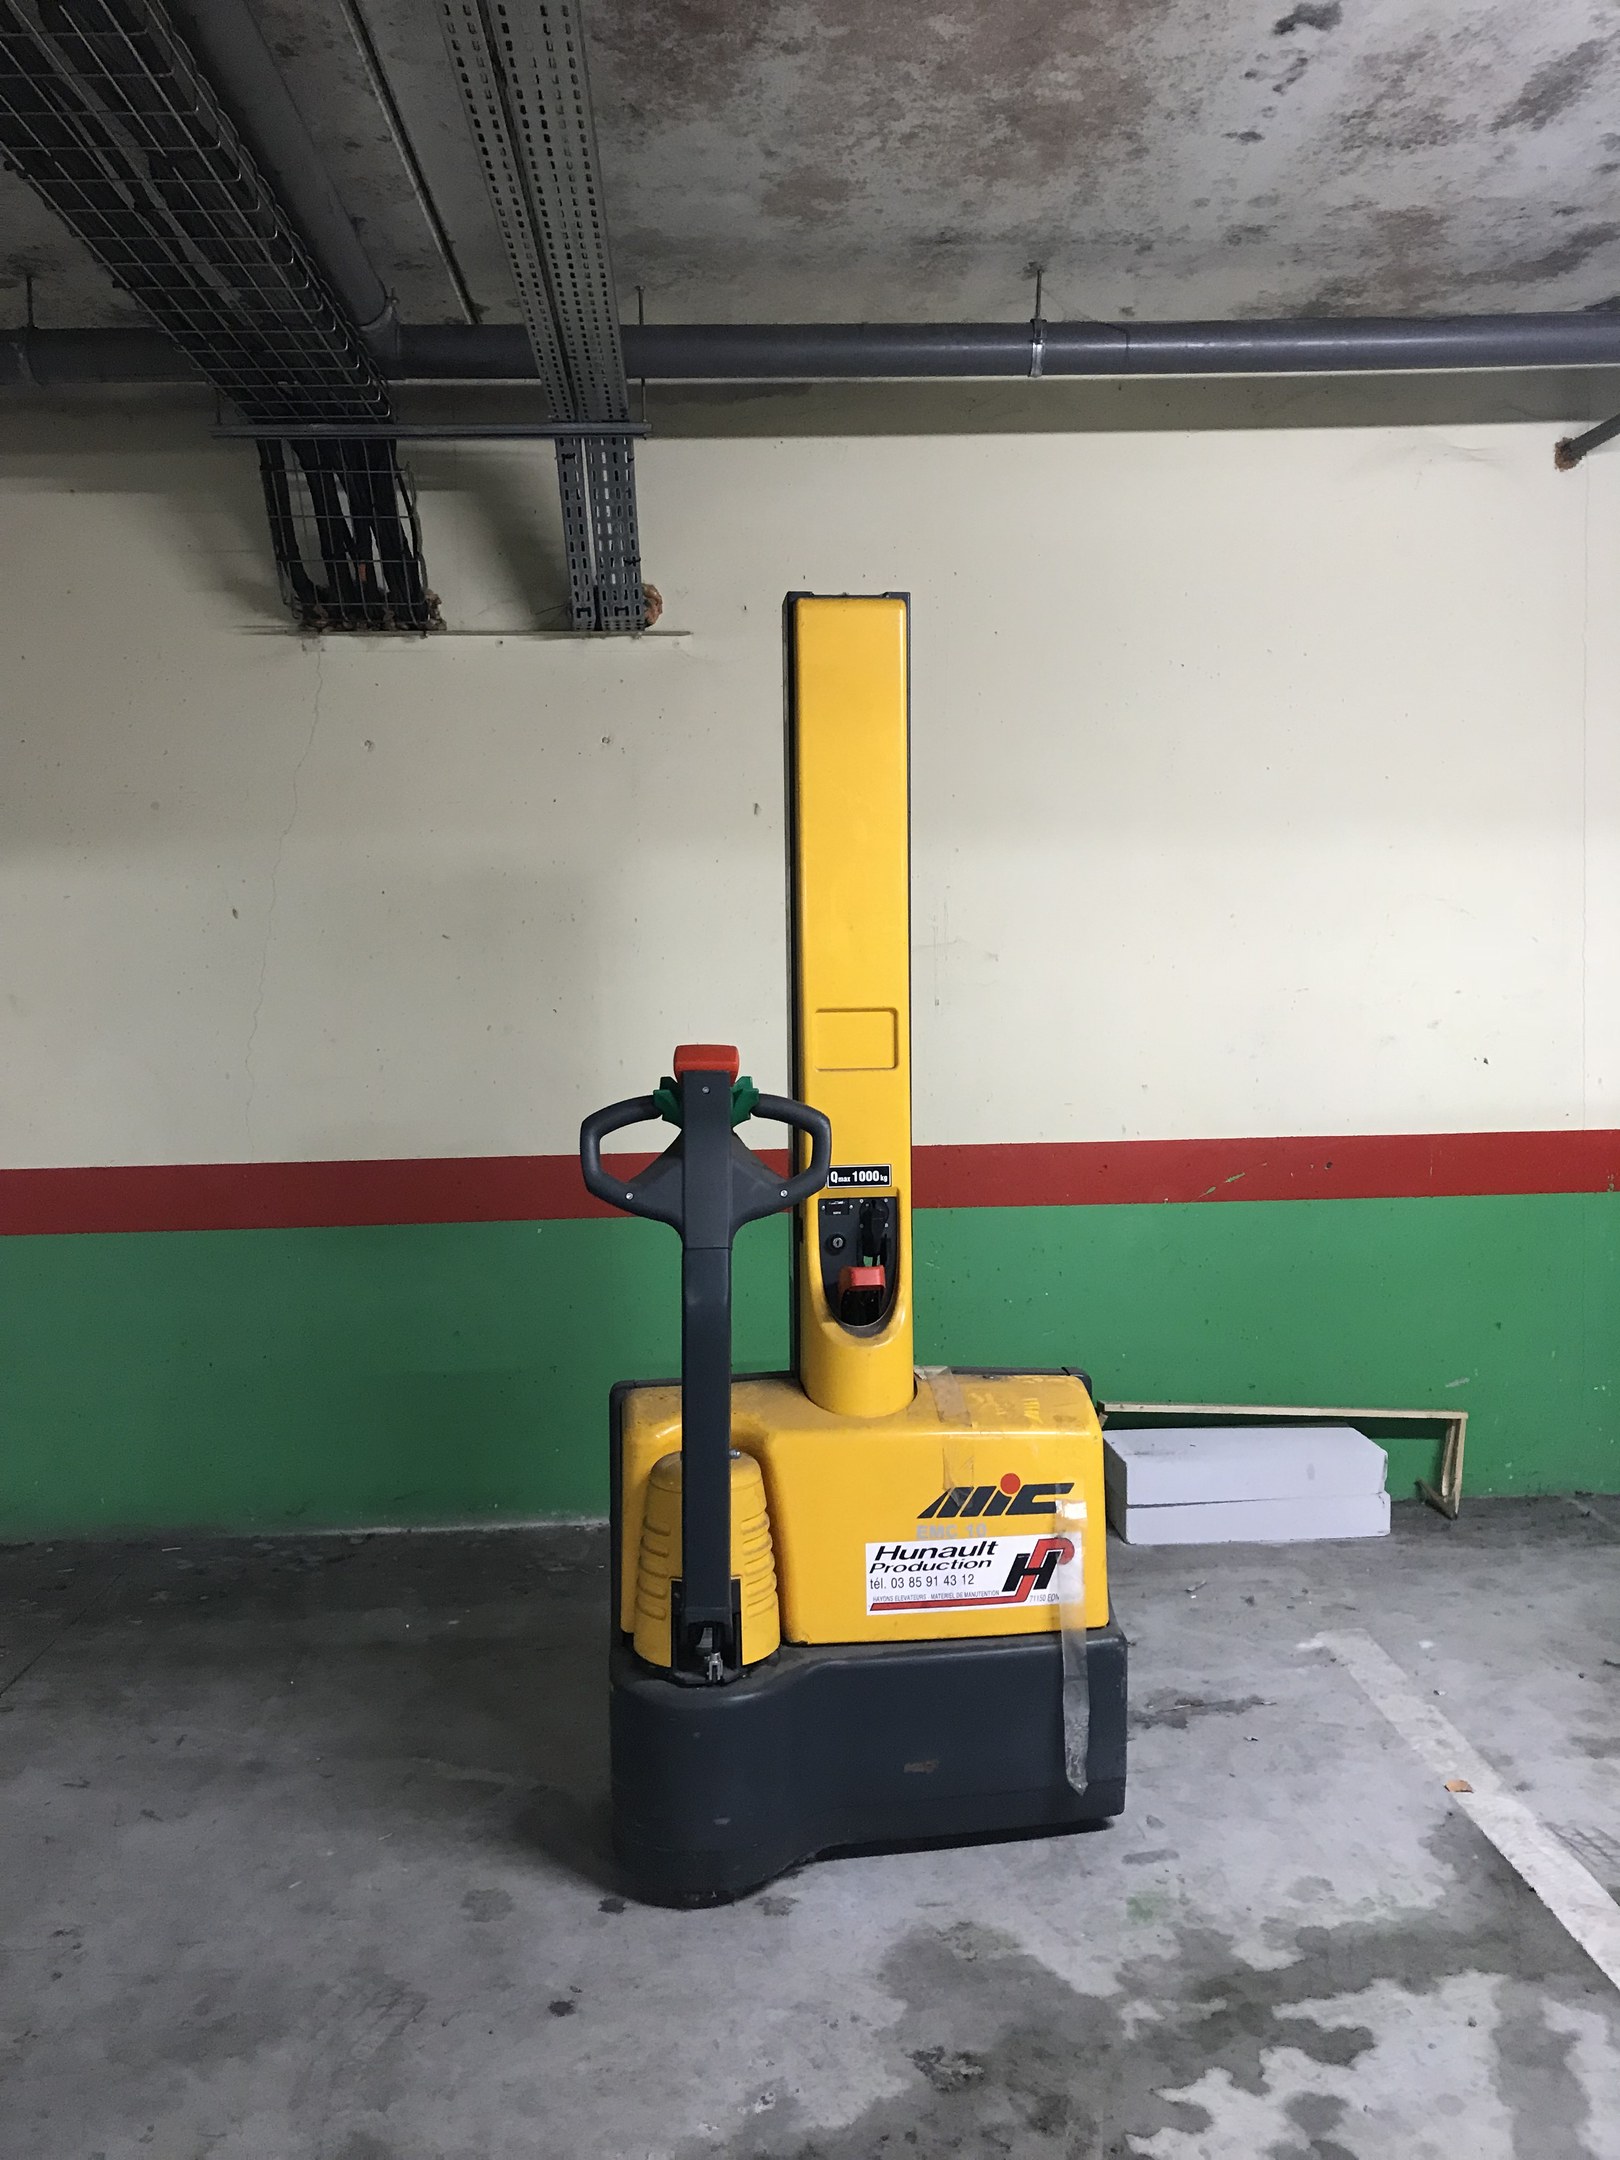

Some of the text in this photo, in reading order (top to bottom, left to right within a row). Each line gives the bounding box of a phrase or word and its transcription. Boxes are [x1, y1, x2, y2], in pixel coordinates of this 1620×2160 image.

[916, 1523, 987, 1540] EMC 10
[875, 1541, 998, 1561] Hunault
[869, 1558, 992, 1574] Production
[869, 1573, 975, 1590] tél. 03 85 91 43 12
